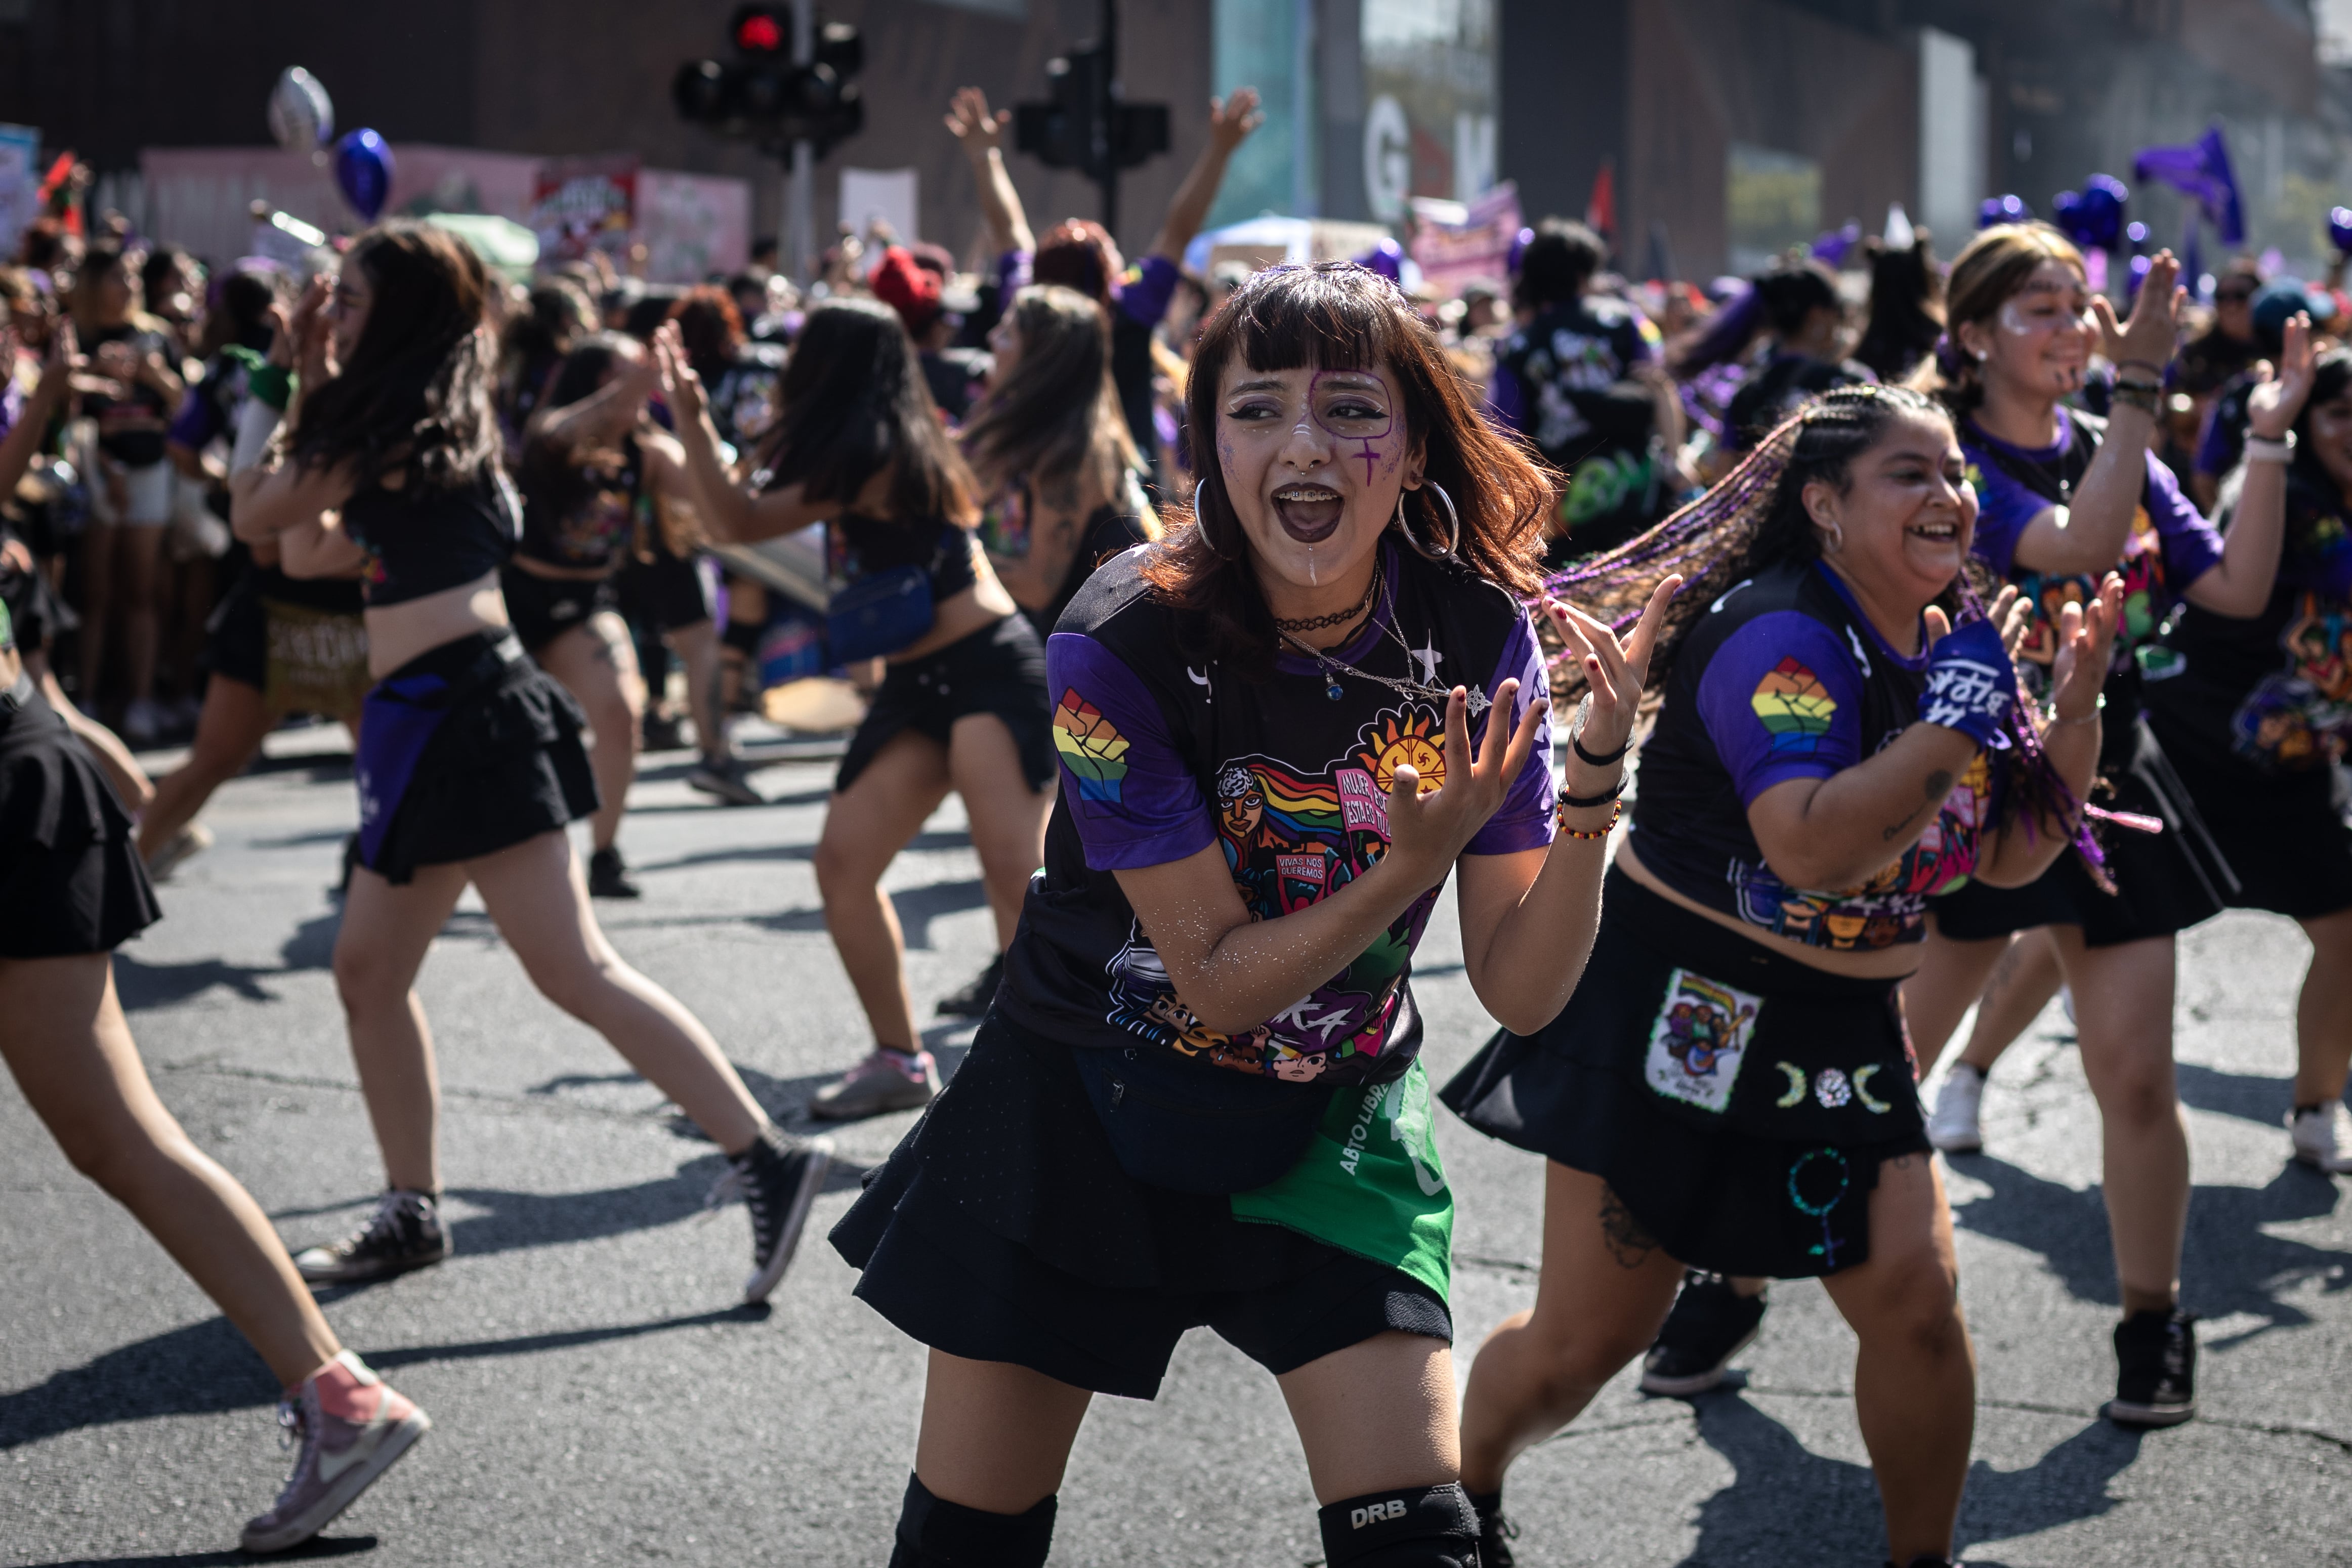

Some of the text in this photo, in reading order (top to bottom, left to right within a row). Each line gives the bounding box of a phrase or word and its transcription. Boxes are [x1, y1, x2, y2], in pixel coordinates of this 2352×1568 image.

[1341, 772, 1373, 803] MUJER,
[1364, 801, 1375, 825] ES
[1375, 810, 1385, 834] TU
[1279, 858, 1322, 868] VIVAS NOS
[1281, 867, 1323, 879] QUEREMOS
[1351, 1499, 1407, 1530] DRB
